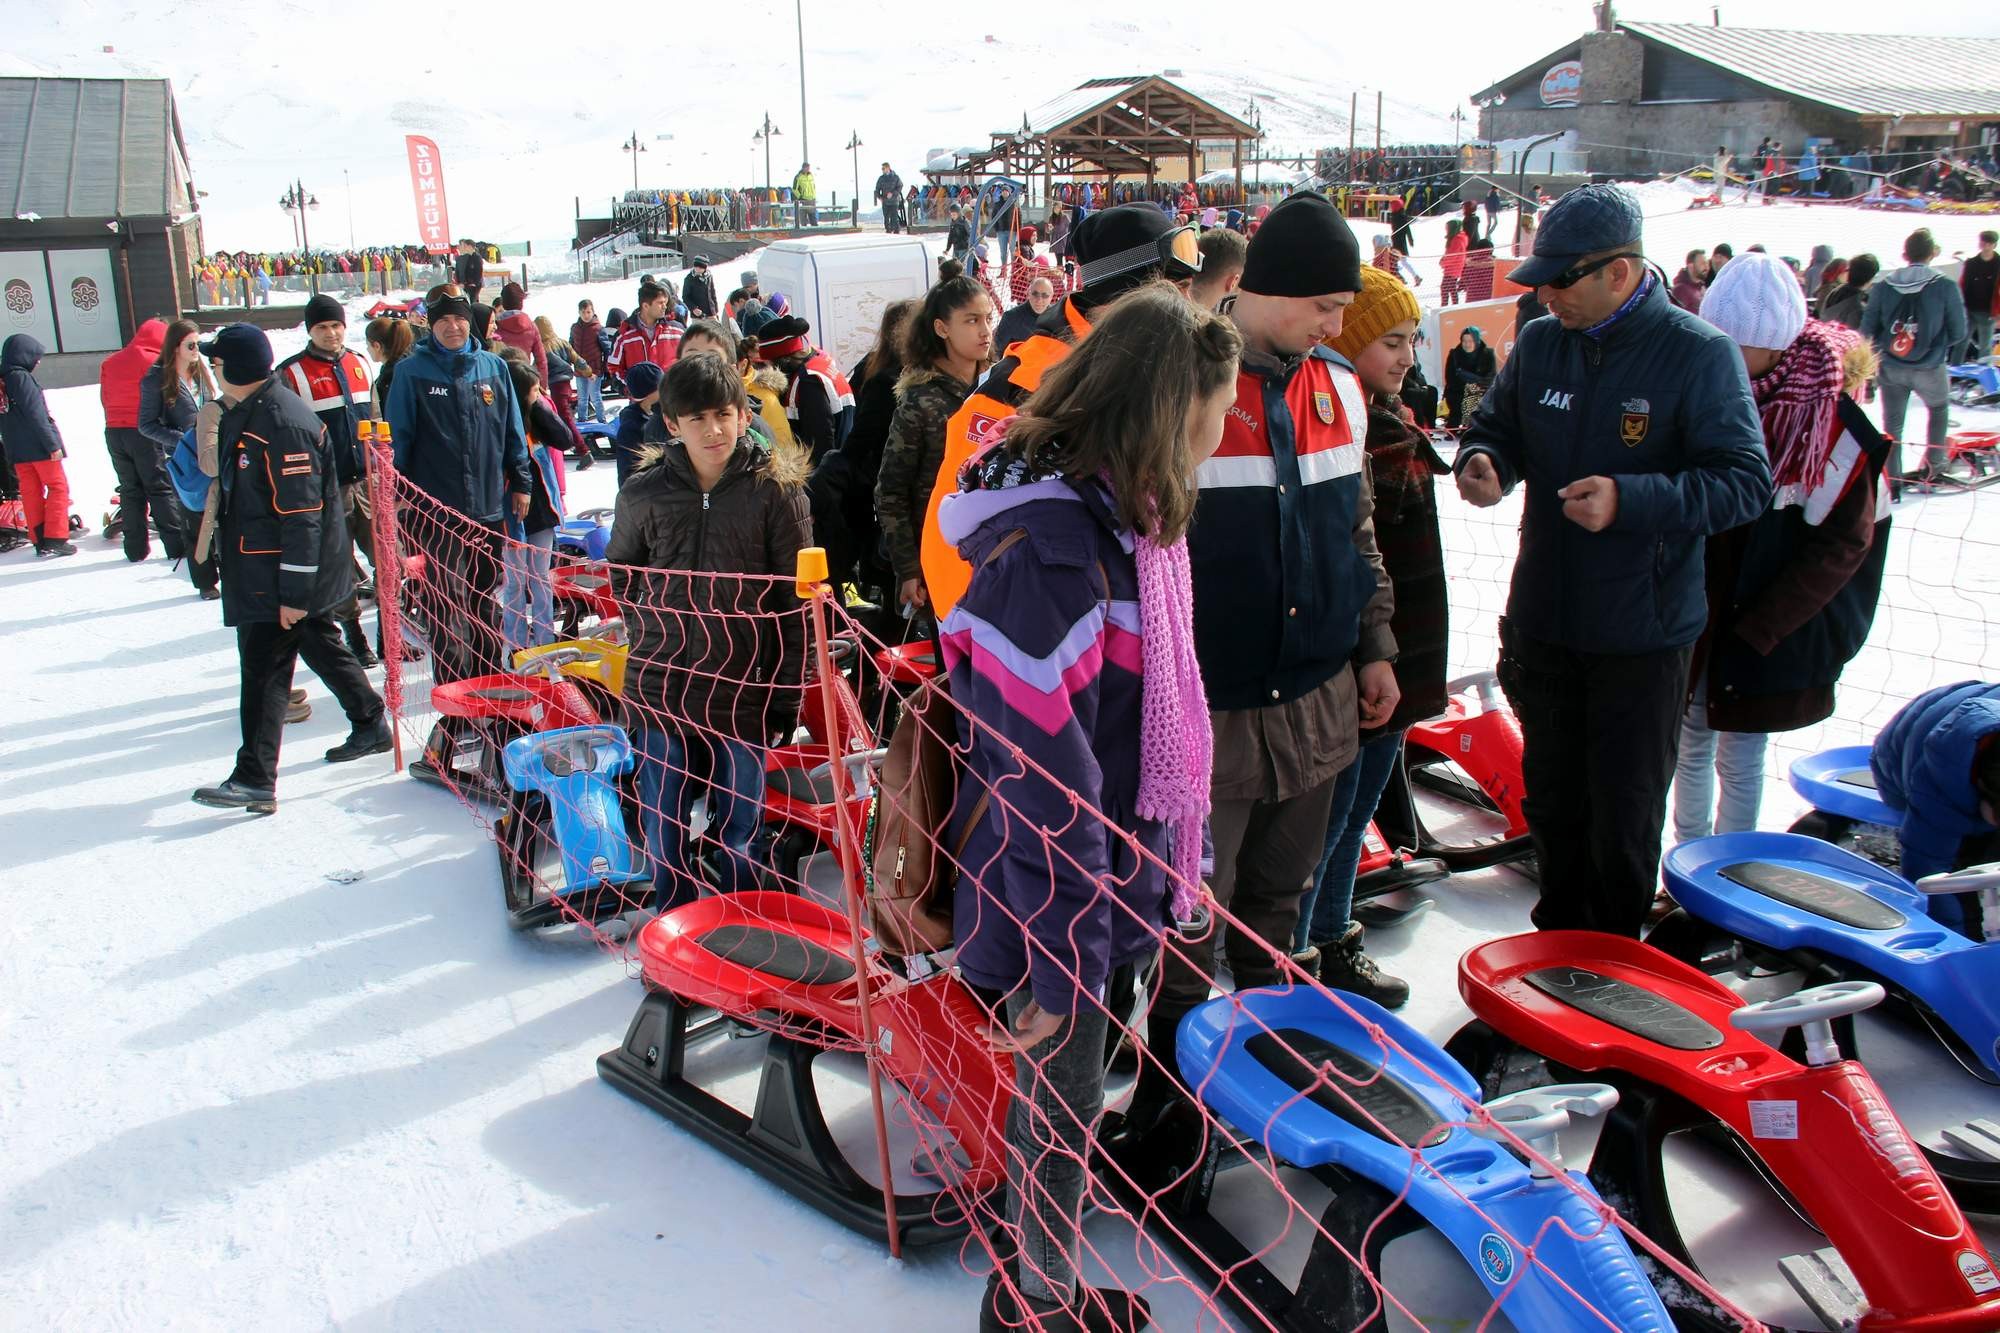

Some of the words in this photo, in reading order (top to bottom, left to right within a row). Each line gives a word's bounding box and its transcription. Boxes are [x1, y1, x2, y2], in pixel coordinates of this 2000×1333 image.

[428, 386, 449, 397] JAK
[1538, 388, 1574, 411] JAK
[1549, 972, 1699, 1031] SNOW
